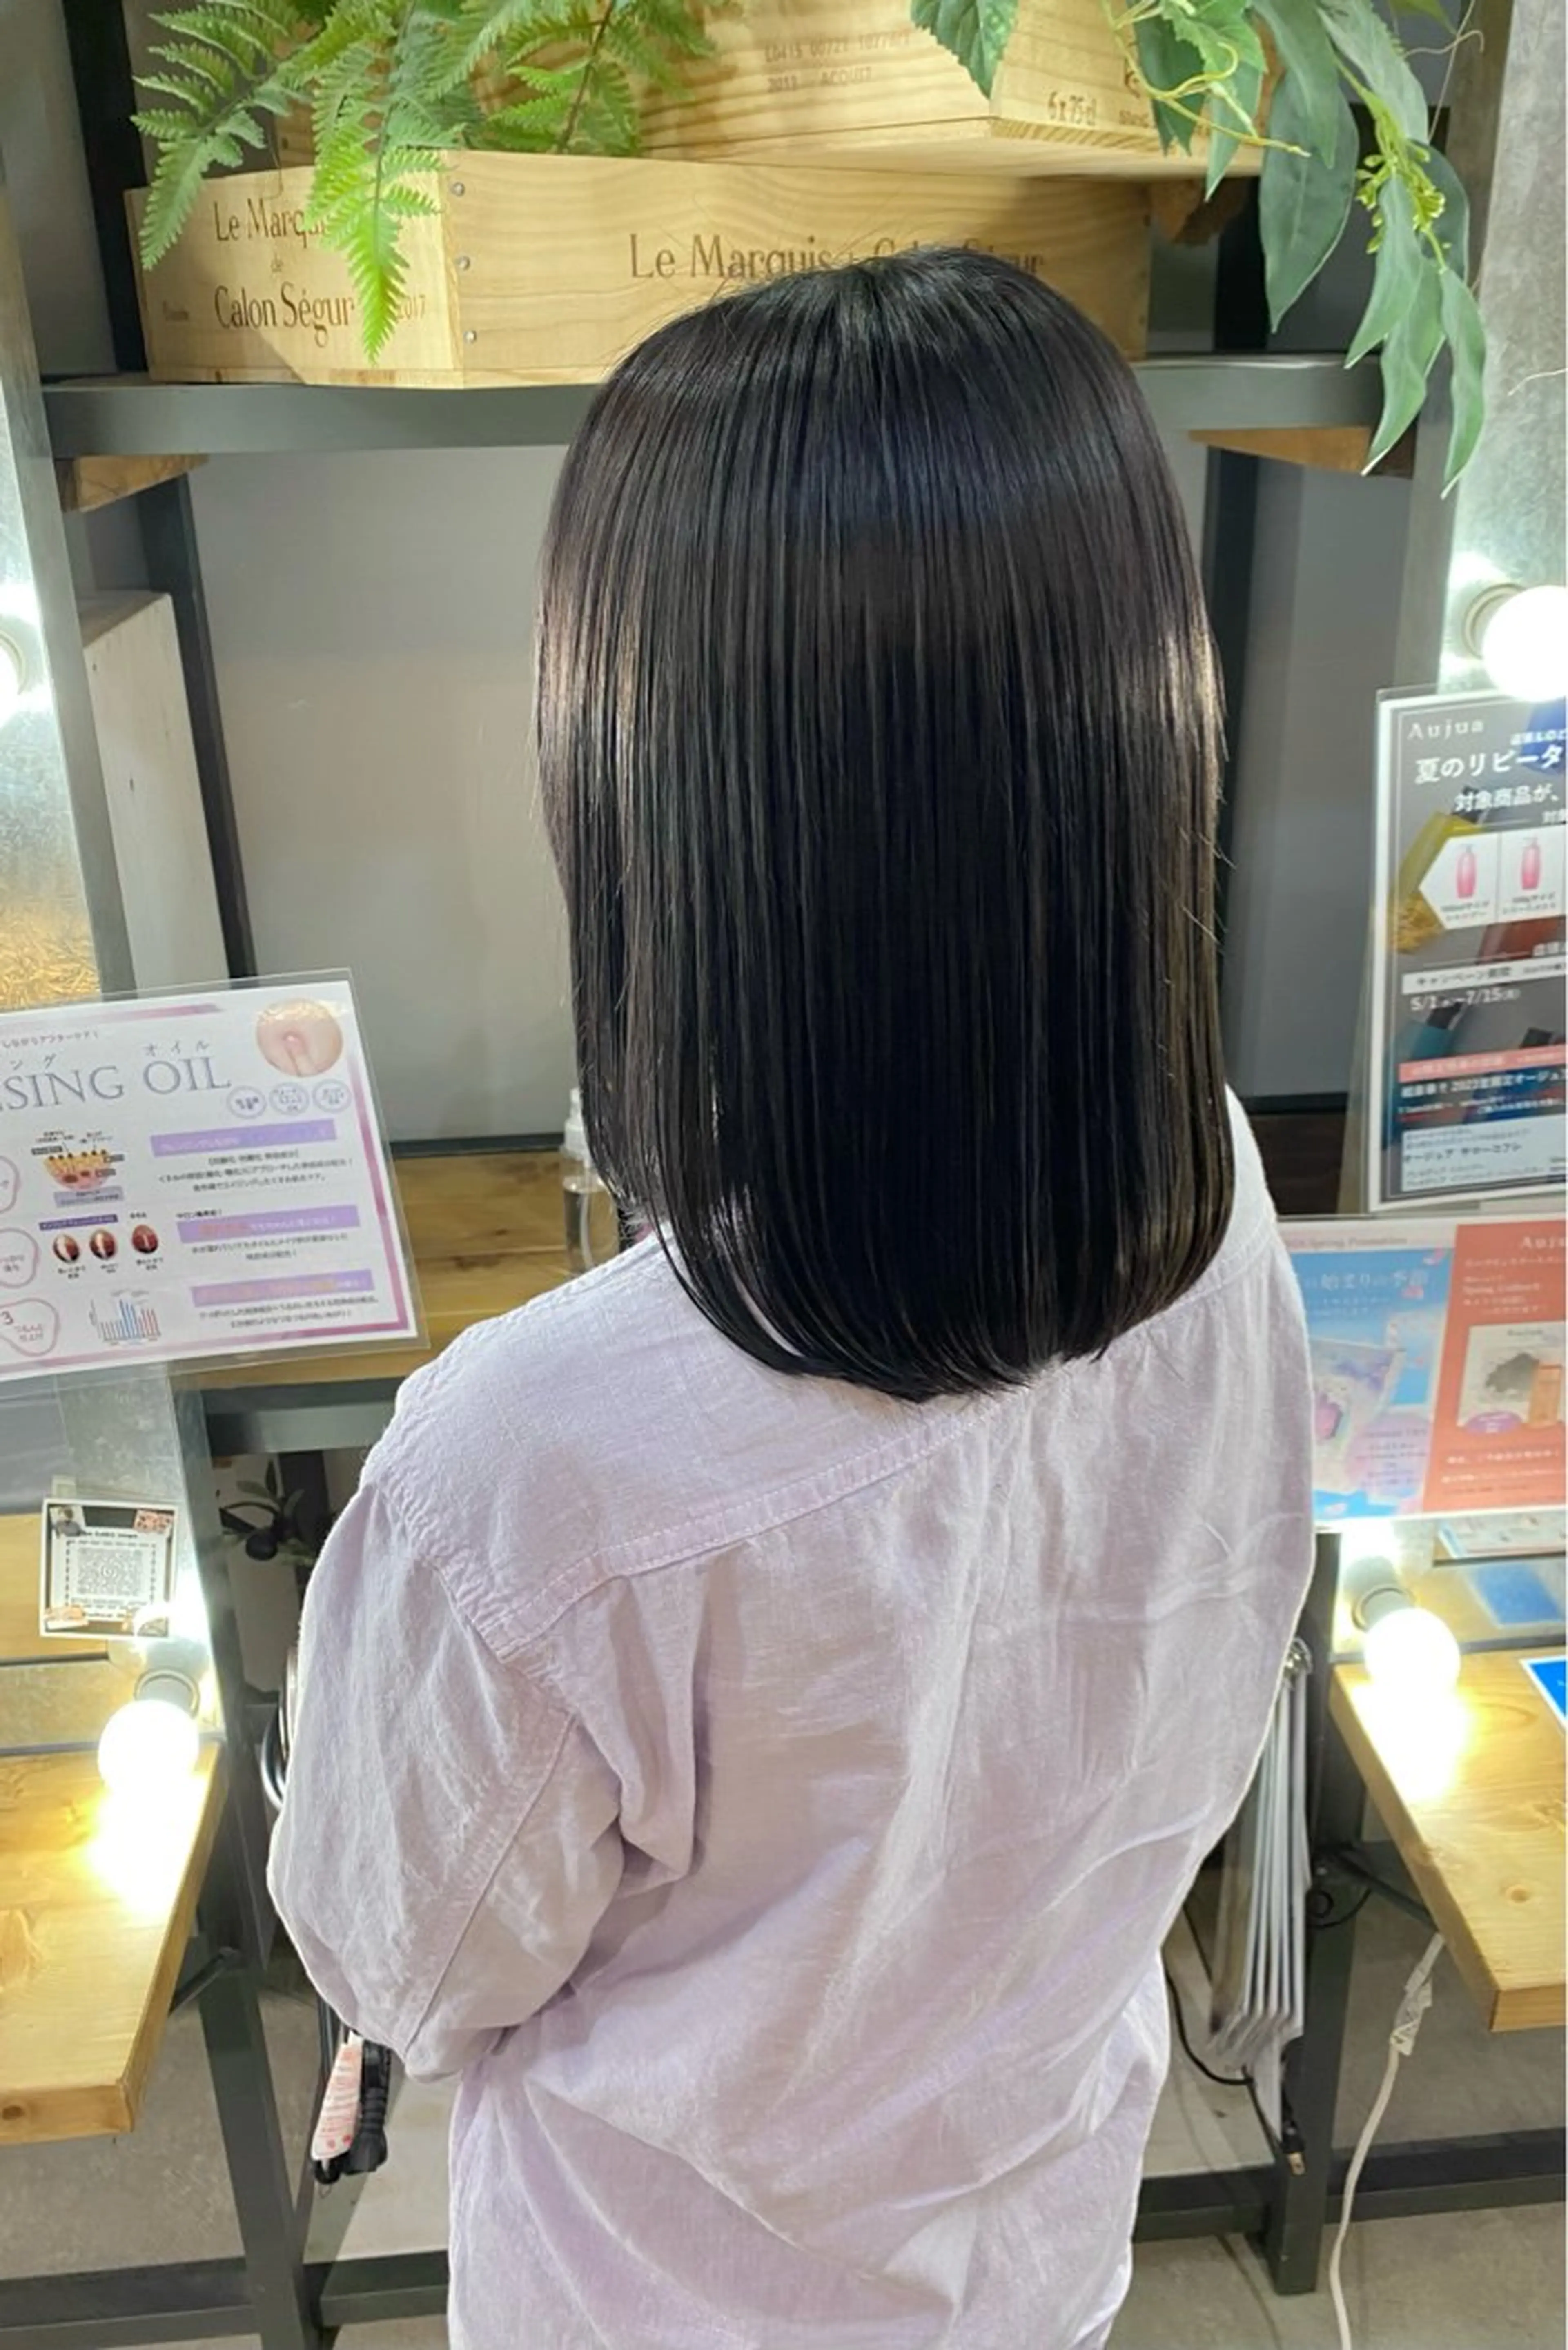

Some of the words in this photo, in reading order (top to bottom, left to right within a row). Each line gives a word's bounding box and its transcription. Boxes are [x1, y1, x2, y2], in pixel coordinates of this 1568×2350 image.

[214, 200, 240, 242] Le
[630, 234, 675, 278] Le
[214, 285, 277, 329] Calon
[281, 281, 354, 348] Ségur
[1408, 718, 1485, 740] Aujua
[145, 1040, 209, 1057] オイル
[143, 1056, 232, 1094] OIL
